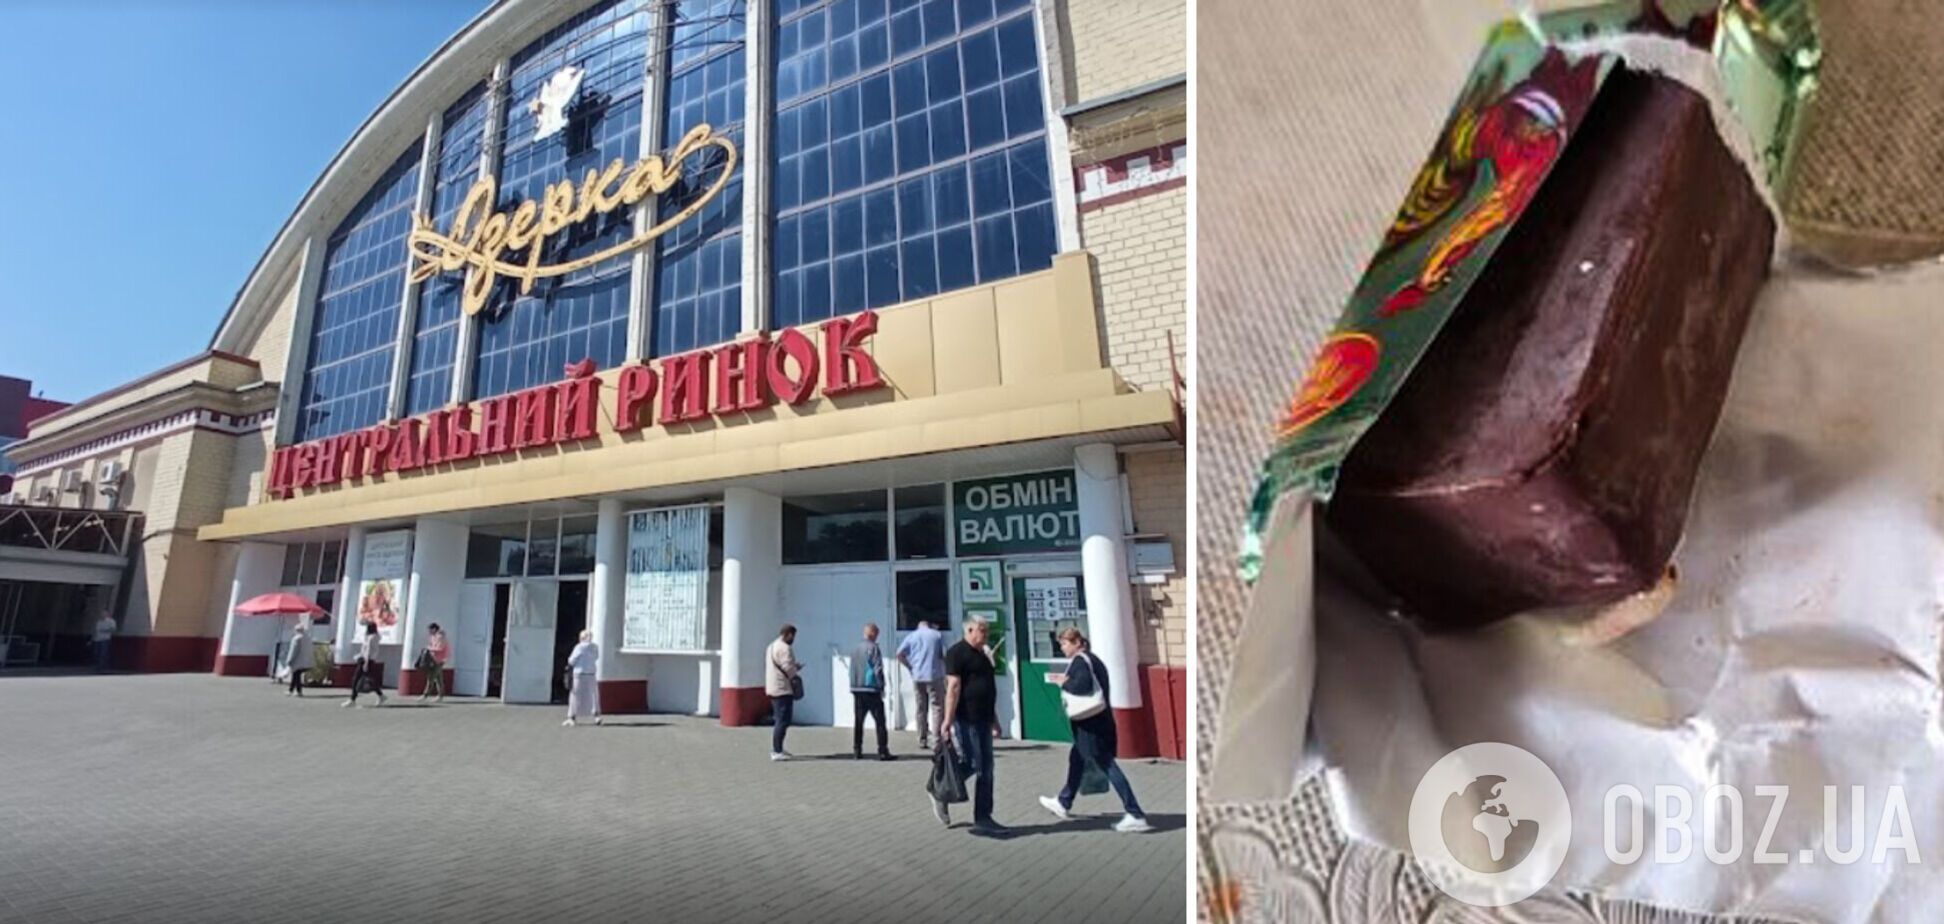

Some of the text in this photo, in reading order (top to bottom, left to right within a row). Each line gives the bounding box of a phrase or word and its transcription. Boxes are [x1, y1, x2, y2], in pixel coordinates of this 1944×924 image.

[267, 311, 886, 500] ЦЕНТРАЛЬНИЙ РИНОК
[965, 477, 1072, 511] ОБМІН
[960, 510, 1080, 544] ВАЛЮТ
